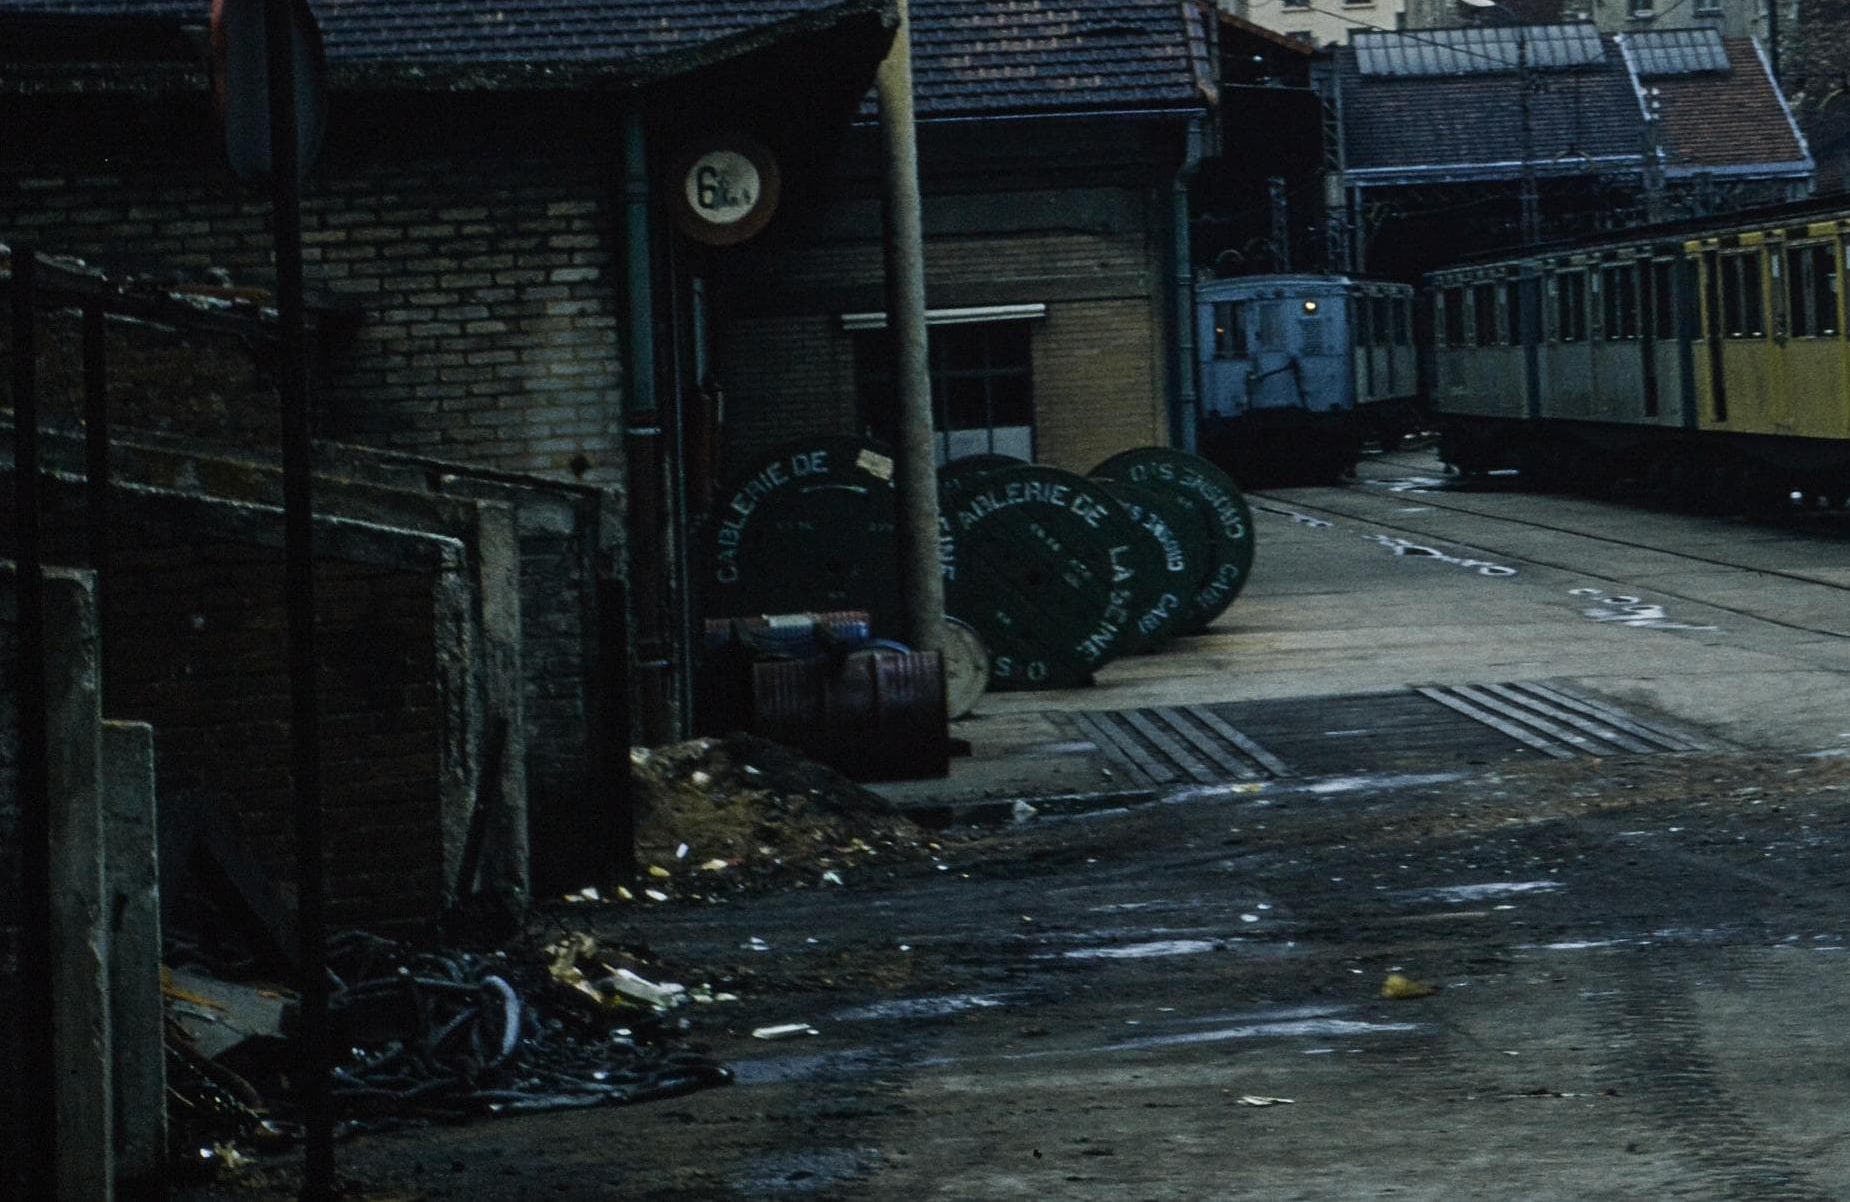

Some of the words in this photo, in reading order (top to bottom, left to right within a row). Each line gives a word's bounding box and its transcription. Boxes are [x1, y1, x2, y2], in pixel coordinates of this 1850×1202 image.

[716, 462, 790, 584] CABLERIE
[792, 451, 830, 477] DE
[957, 481, 1071, 531] ABLERIE
[1069, 493, 1109, 529] DE
[1108, 545, 1135, 583] LA
[1074, 590, 1132, 663] SEINE
